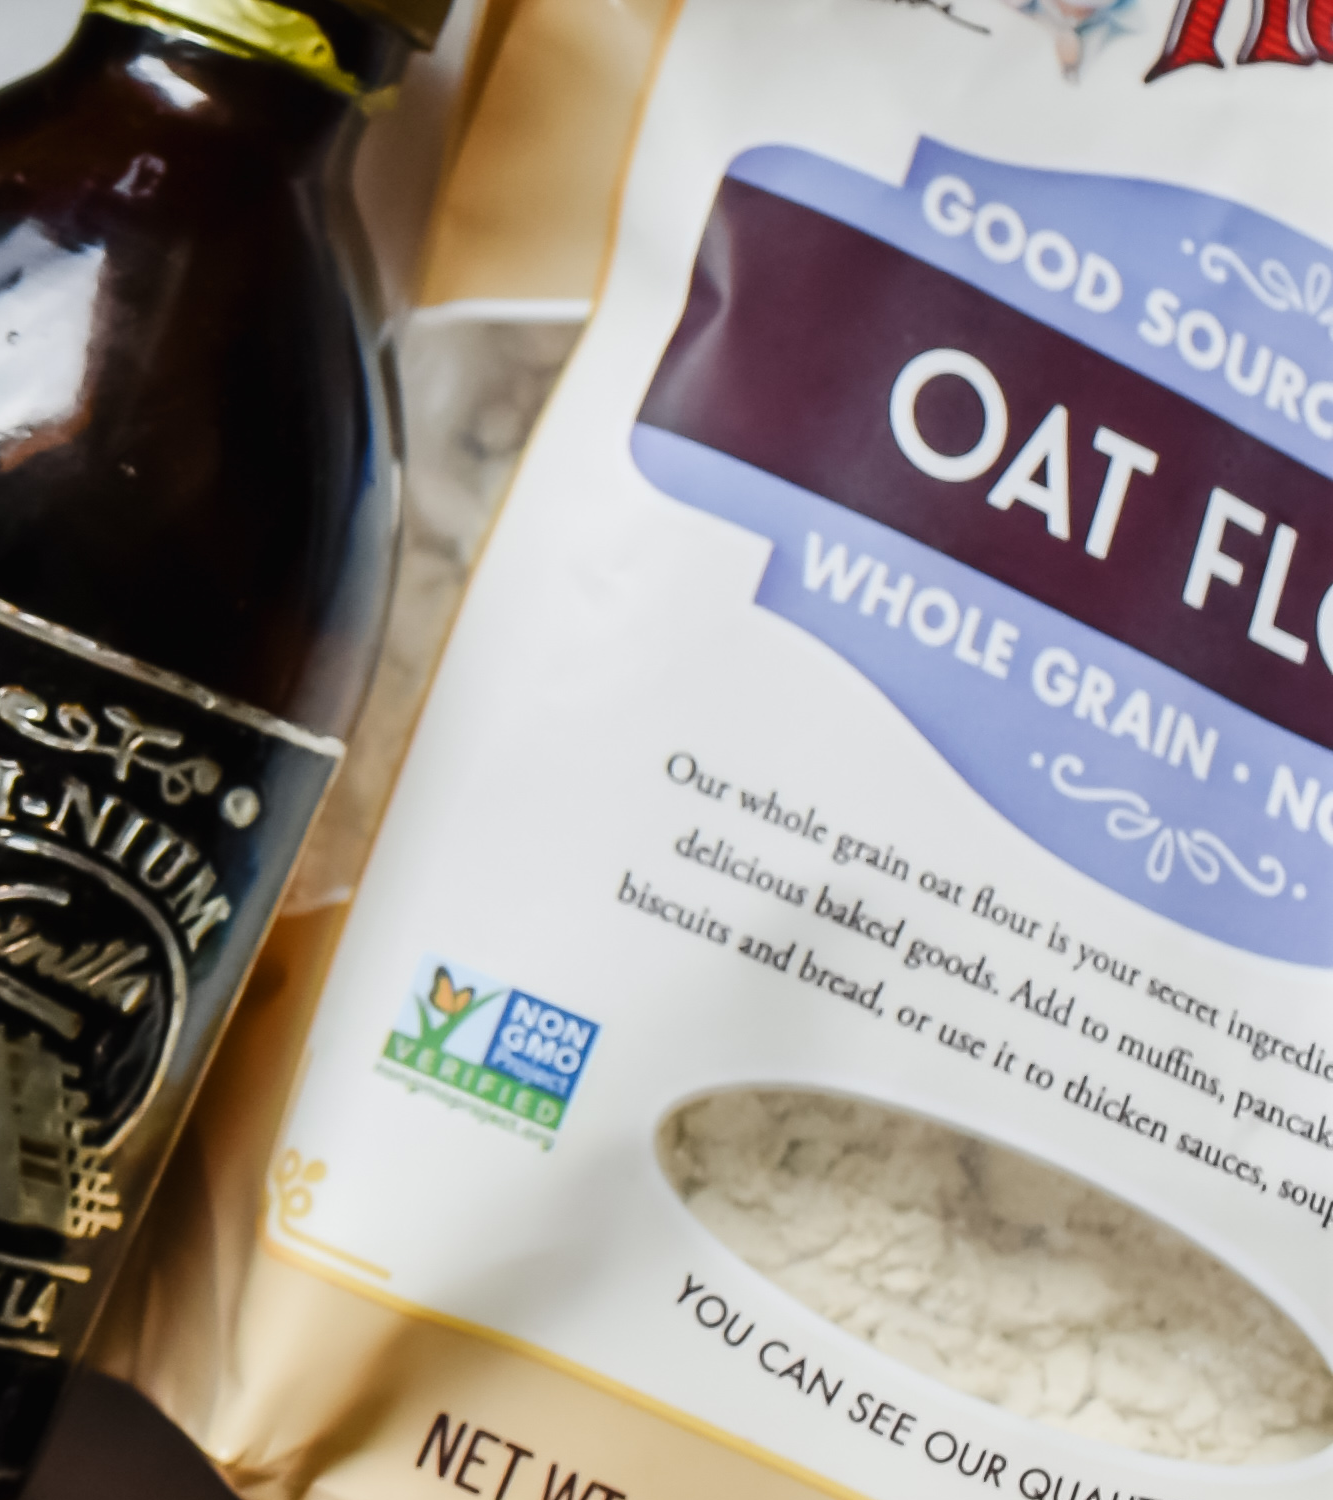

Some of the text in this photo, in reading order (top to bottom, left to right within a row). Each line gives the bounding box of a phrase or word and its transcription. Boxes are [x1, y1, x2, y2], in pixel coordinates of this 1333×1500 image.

[919, 172, 1124, 315] GOOD
[887, 344, 1159, 562] OAT
[799, 530, 1220, 783] WHOLE GRAIN
[665, 750, 1222, 1029] Our whole grain oat flour your secret
[672, 827, 1077, 1028] delicious baked Add
[392, 1036, 561, 1125] VERIFIED
[499, 1023, 582, 1075] GMO
[511, 996, 592, 1050] NON
[615, 870, 1269, 1194] biscuits and bread, use thicken sauces,
[675, 1272, 1010, 1490] YOU CAN SEE OUR
